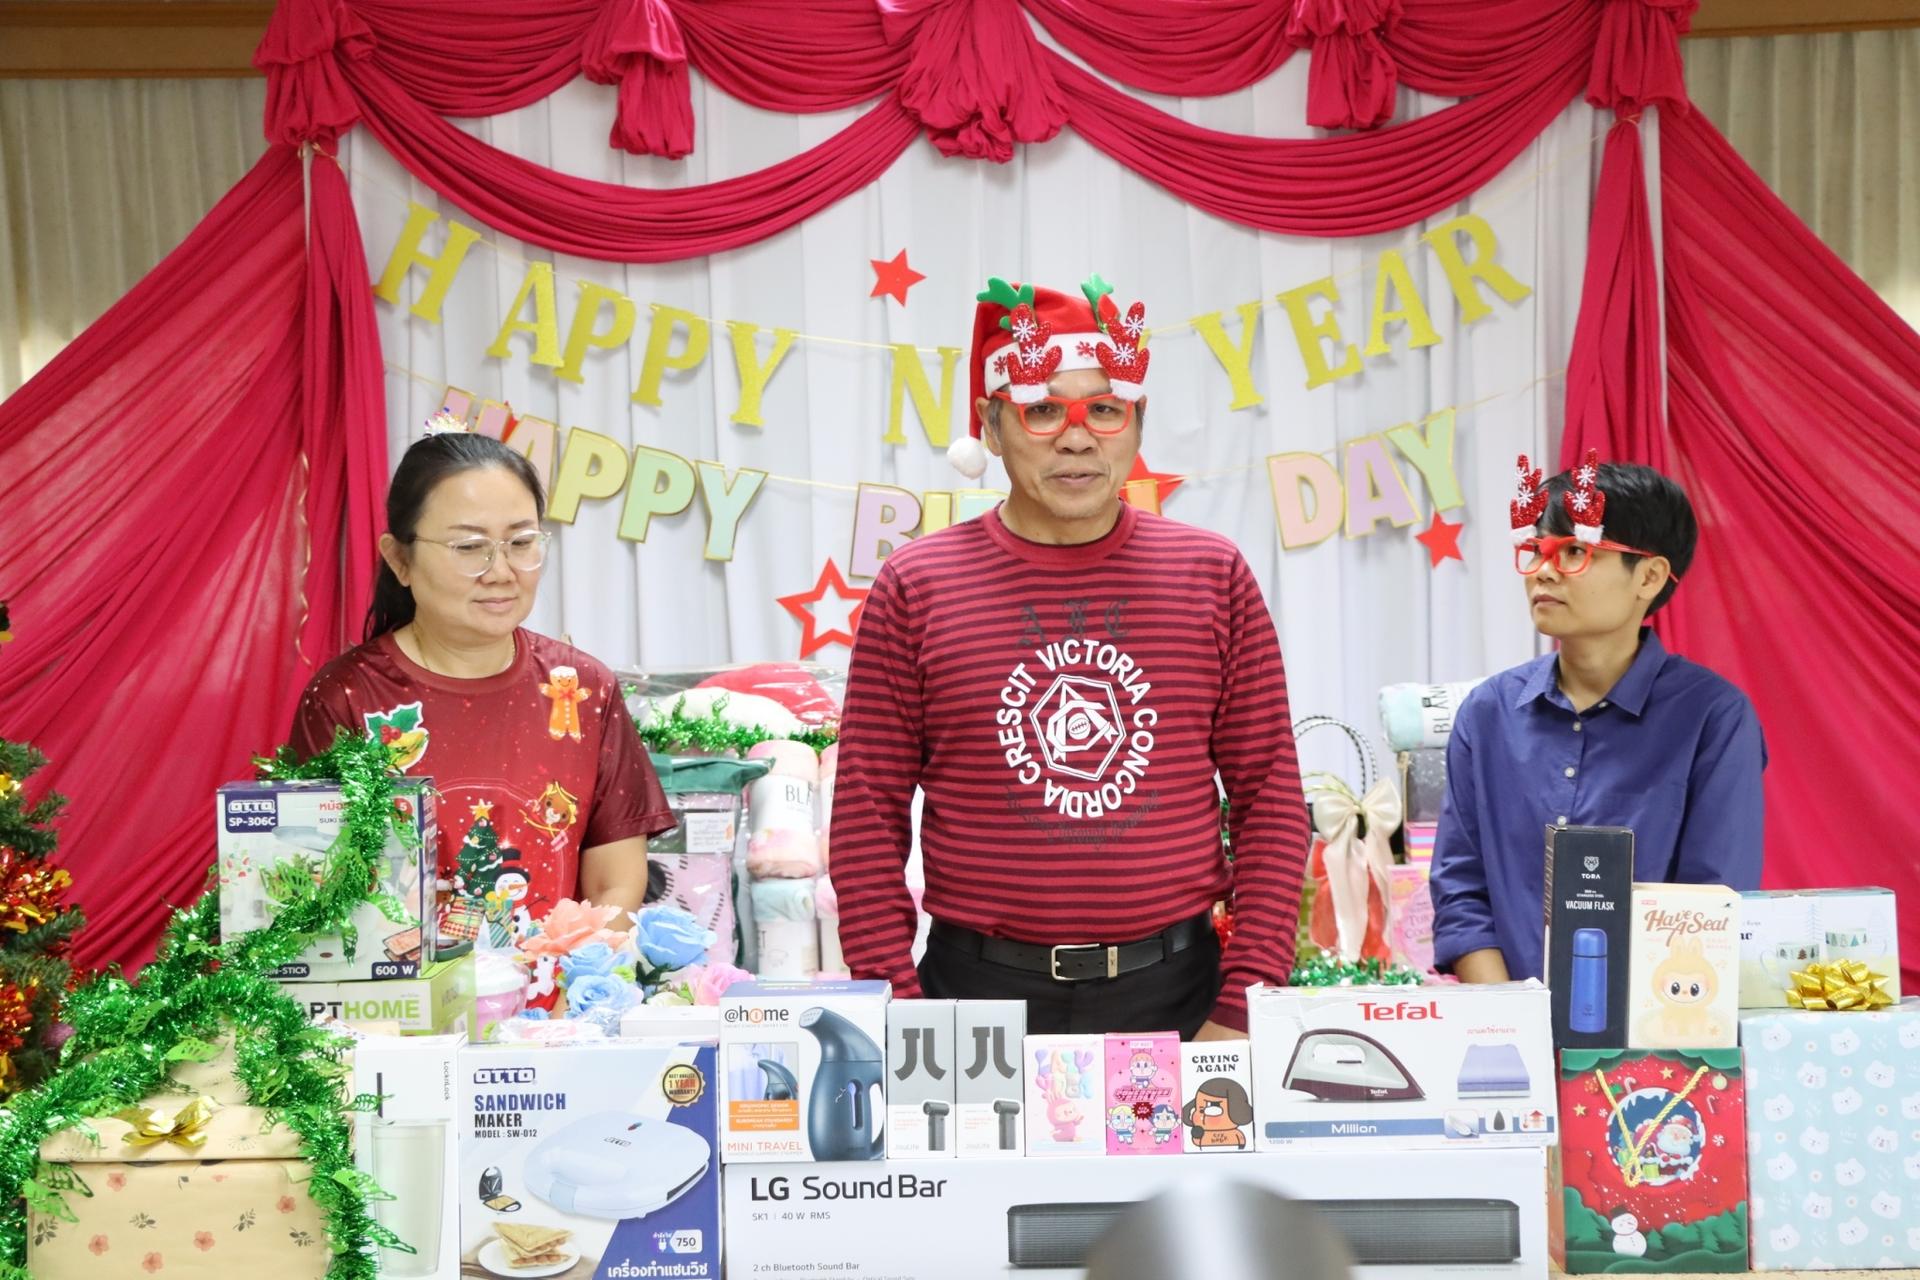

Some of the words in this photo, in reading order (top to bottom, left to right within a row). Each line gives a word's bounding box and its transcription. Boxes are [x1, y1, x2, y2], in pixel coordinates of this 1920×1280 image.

[374, 200, 798, 428] HAPPY
[1191, 213, 1532, 412] YEAR
[1265, 407, 1465, 550] DAY
[1035, 638, 1151, 705] VICTORIA
[996, 662, 1041, 785] CRESCIT
[1044, 708, 1158, 818] CONCORDIA
[228, 800, 275, 813] OTTO
[229, 816, 275, 827] SP-306C
[1565, 900, 1593, 910] VACUUM
[1594, 901, 1615, 911] FLASK
[1644, 909, 1692, 931] Have
[1687, 911, 1729, 934] Seat
[375, 965, 398, 976] 600
[402, 965, 414, 975] W
[1357, 1001, 1443, 1021] Tefal
[1191, 1054, 1240, 1064] CRYING
[1196, 1063, 1237, 1073] AGAIN
[474, 1067, 536, 1084] OTTO
[668, 1080, 674, 1088] 1
[675, 1080, 695, 1088] YEAR
[474, 1093, 566, 1111] SANDWICH
[474, 1113, 522, 1127] MAKER
[475, 1130, 500, 1138] MODEL
[507, 1129, 537, 1138] SW-012
[1331, 1122, 1377, 1134] Million
[727, 1141, 753, 1151] MINI
[756, 1141, 804, 1151] TRAVEL
[751, 1176, 790, 1201] LG
[752, 1213, 769, 1221] SK1
[782, 1212, 793, 1220] 40
[796, 1212, 805, 1220] W
[810, 1211, 831, 1220] RMS
[676, 1237, 696, 1247] 750
[753, 1264, 759, 1272] 2
[761, 1263, 771, 1272] ch
[773, 1262, 815, 1271] Bluetooth
[817, 1262, 844, 1271] Sound
[845, 1262, 860, 1271] Bar
